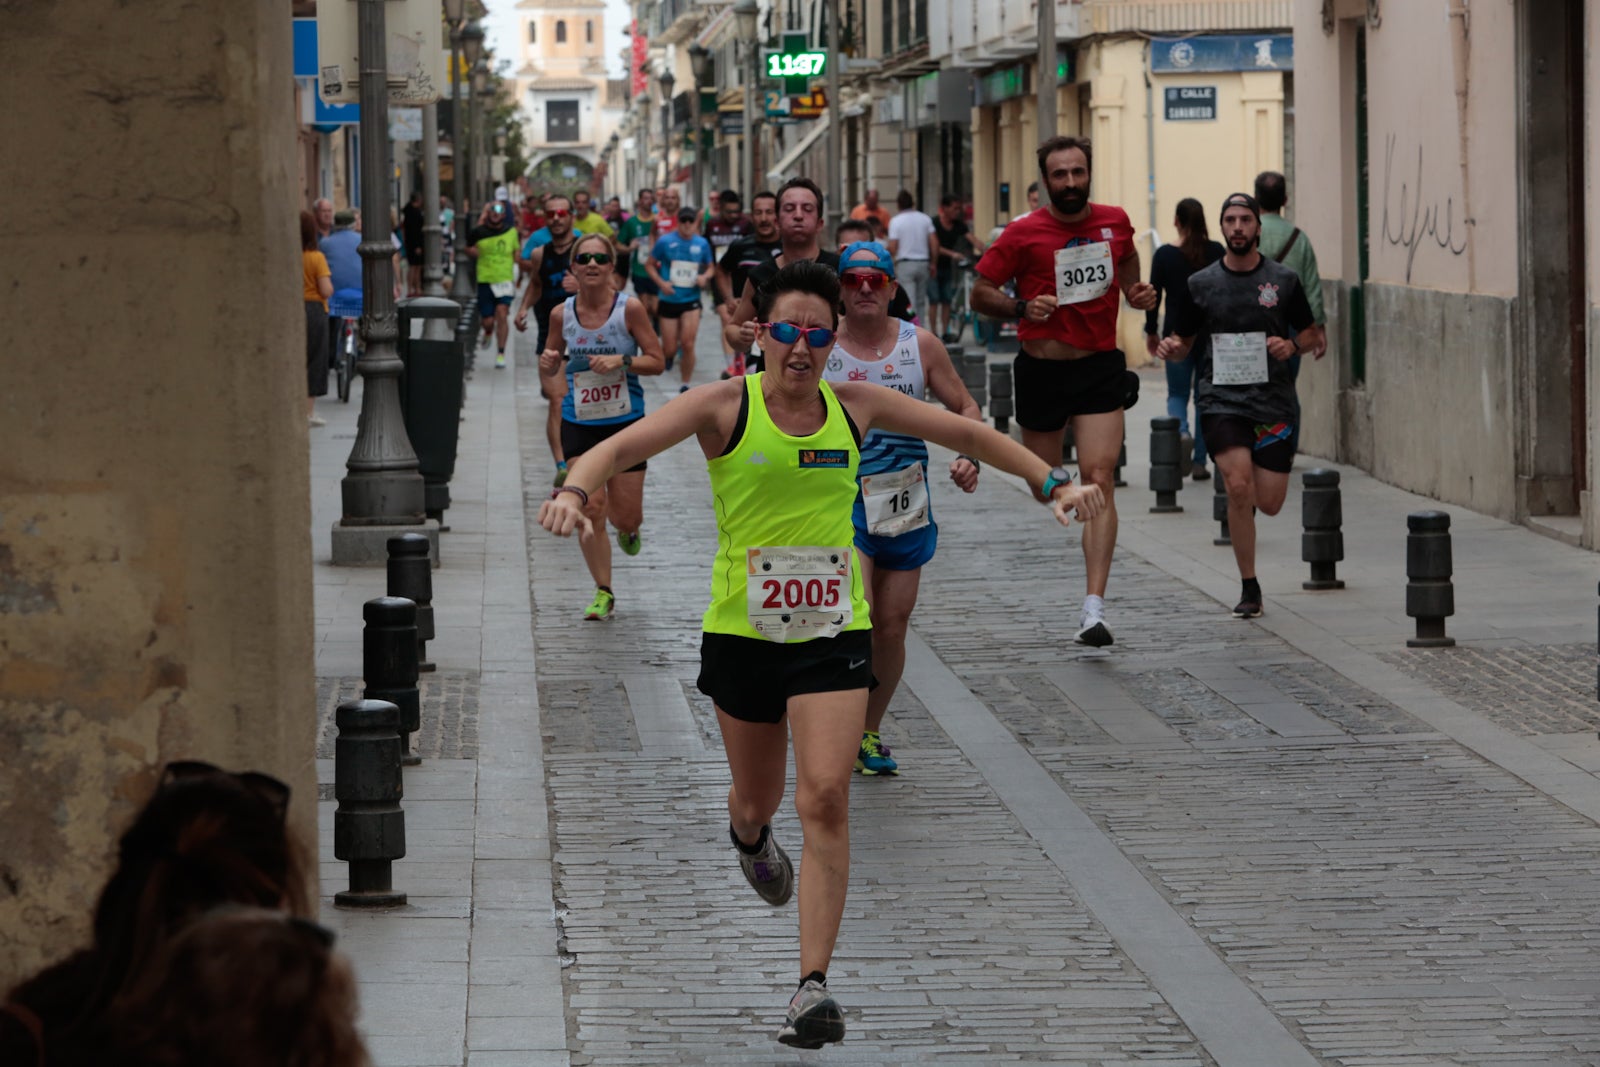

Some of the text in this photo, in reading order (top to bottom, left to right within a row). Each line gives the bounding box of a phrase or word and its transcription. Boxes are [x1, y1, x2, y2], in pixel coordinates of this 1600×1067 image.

[1180, 88, 1212, 98] CALLE
[1064, 264, 1107, 287] 3023
[581, 384, 621, 404] 2097
[889, 490, 909, 513] 16
[762, 579, 840, 608] 2005
